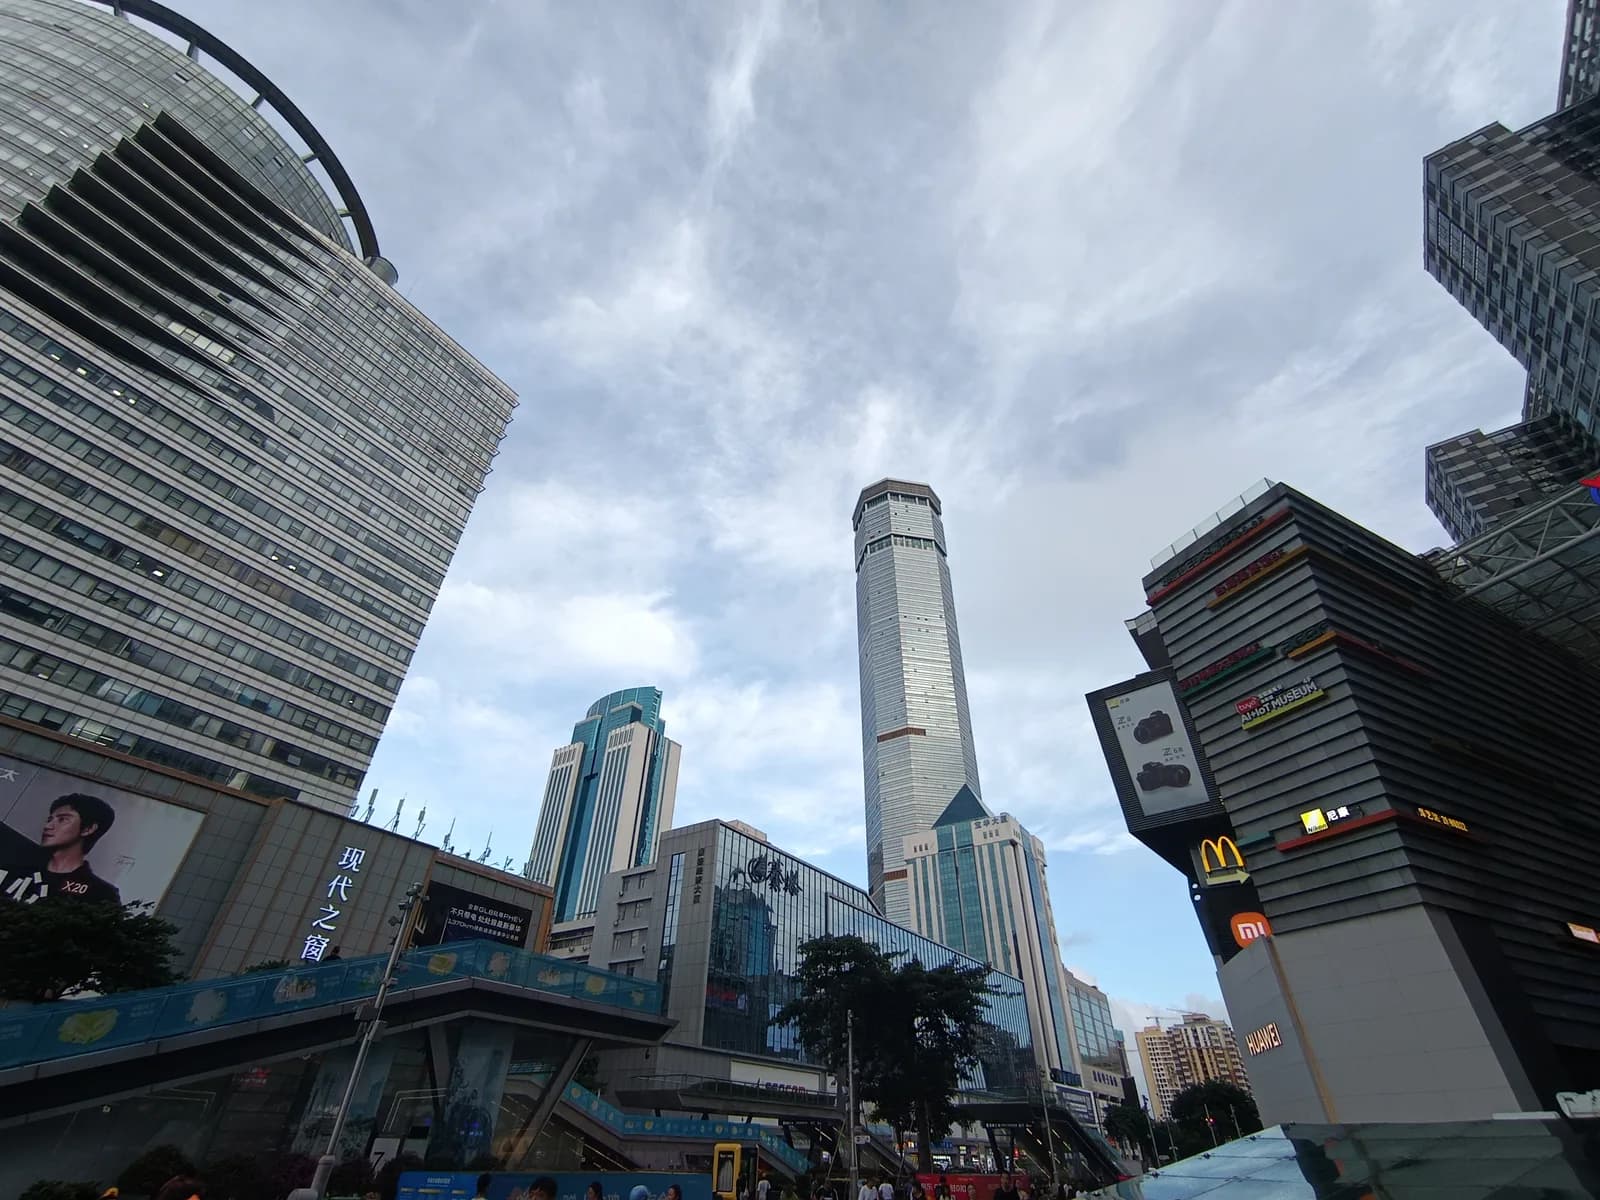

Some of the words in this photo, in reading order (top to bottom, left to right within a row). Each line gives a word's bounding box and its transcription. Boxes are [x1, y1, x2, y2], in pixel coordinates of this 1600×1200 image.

[1241, 703, 1271, 724] AI+IoT
[1272, 682, 1318, 710] MUSEUM
[1308, 824, 1328, 834] Nikon
[62, 880, 88, 894] X20
[301, 846, 365, 961] 现代之窗
[1245, 1022, 1282, 1056] HUAWEI
